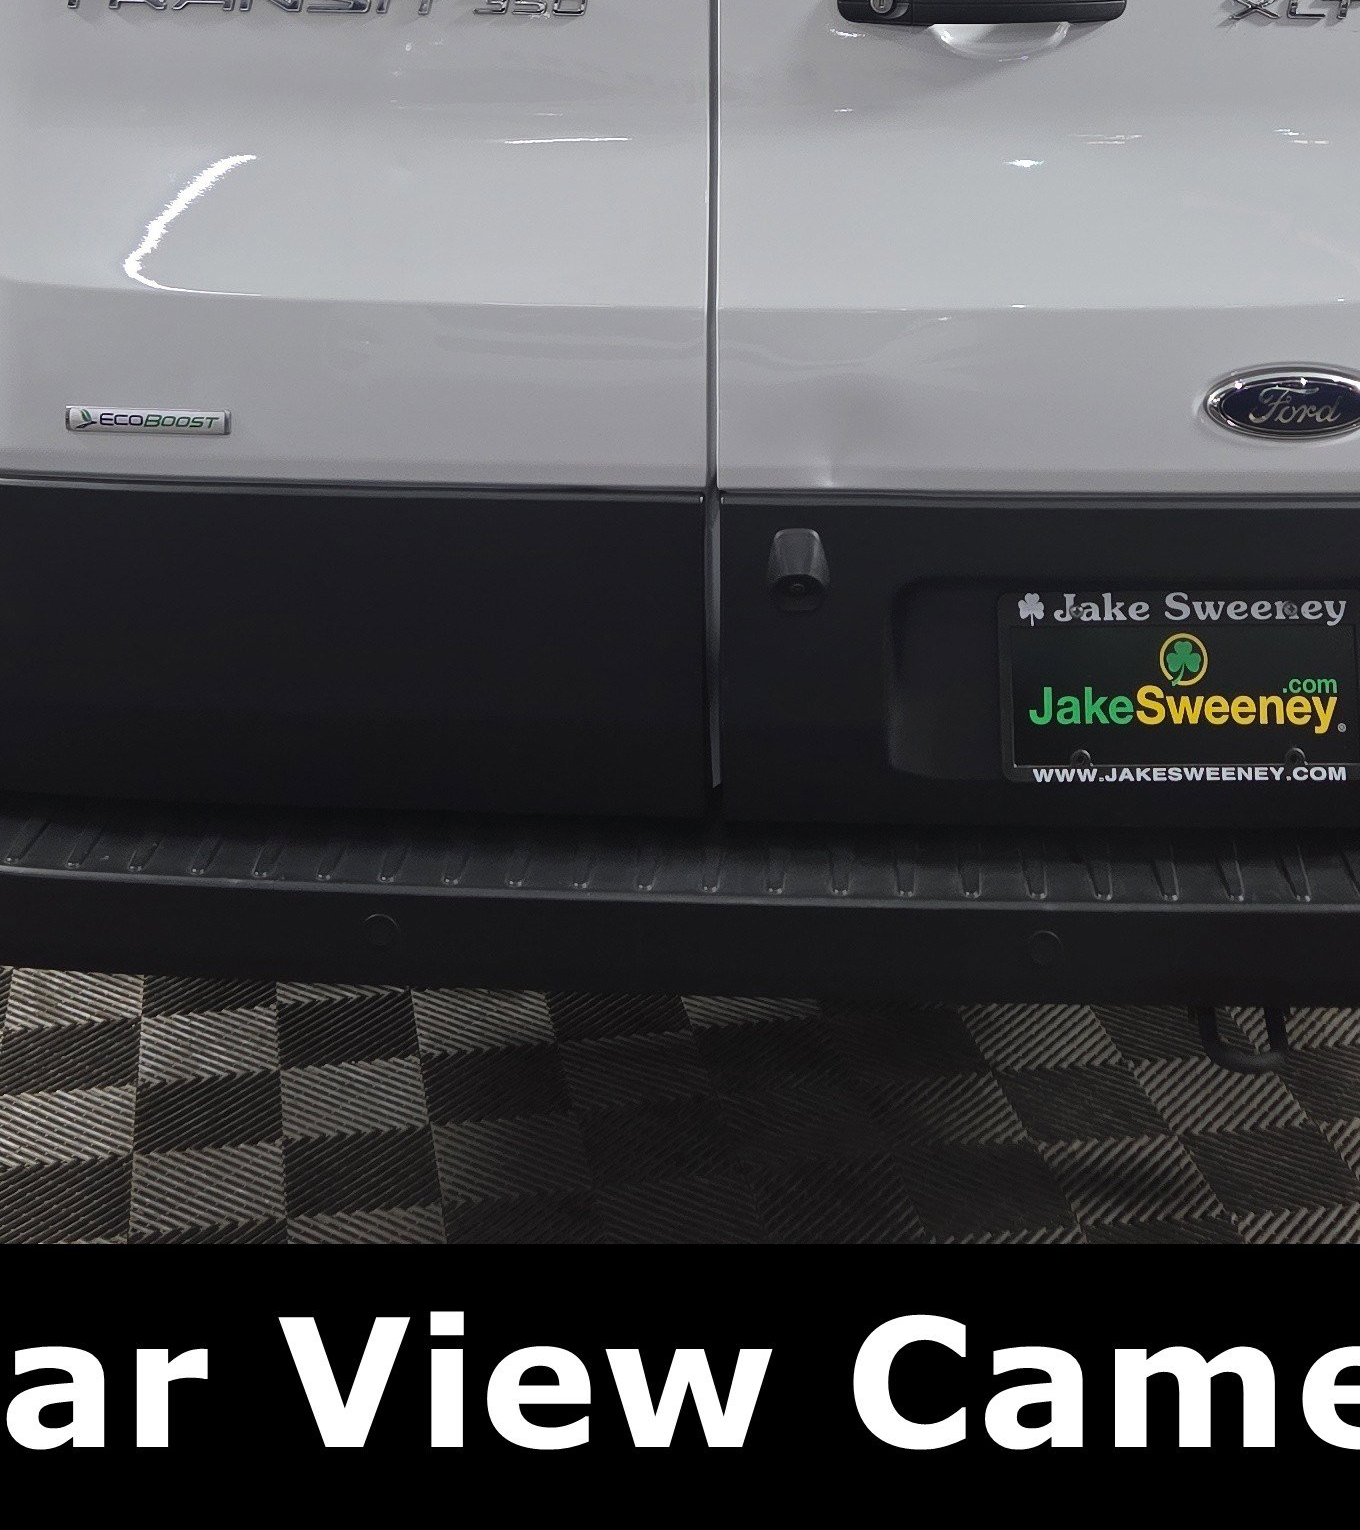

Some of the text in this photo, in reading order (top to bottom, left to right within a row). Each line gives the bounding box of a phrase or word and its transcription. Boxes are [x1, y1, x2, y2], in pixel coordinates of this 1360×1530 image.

[1248, 385, 1341, 424] Ford
[1053, 592, 1347, 626] Jake Sweeney
[1033, 767, 1347, 783] WWW.JAKESWEENEY.COM
